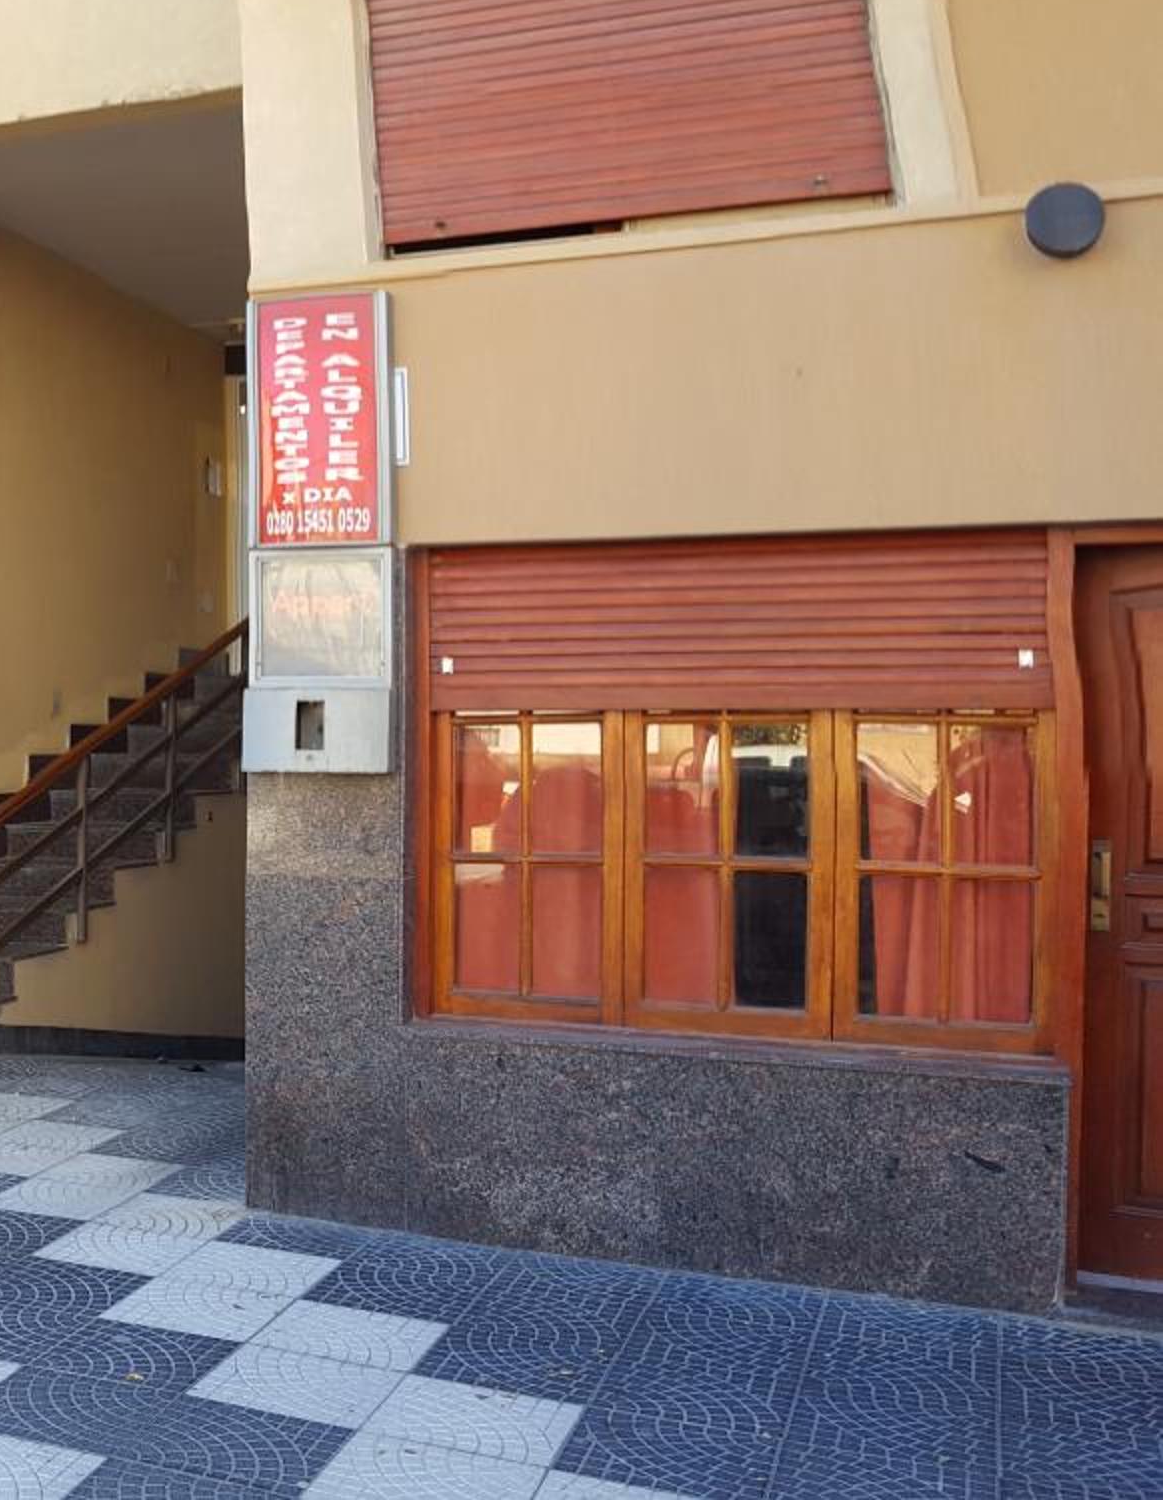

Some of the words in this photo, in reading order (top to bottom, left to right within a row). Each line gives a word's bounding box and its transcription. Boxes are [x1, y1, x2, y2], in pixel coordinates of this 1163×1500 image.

[271, 317, 311, 484] DEPARTAMENTOS
[320, 353, 364, 481] ALQUILER
[304, 486, 353, 503] DIA
[338, 505, 371, 533] 0529
